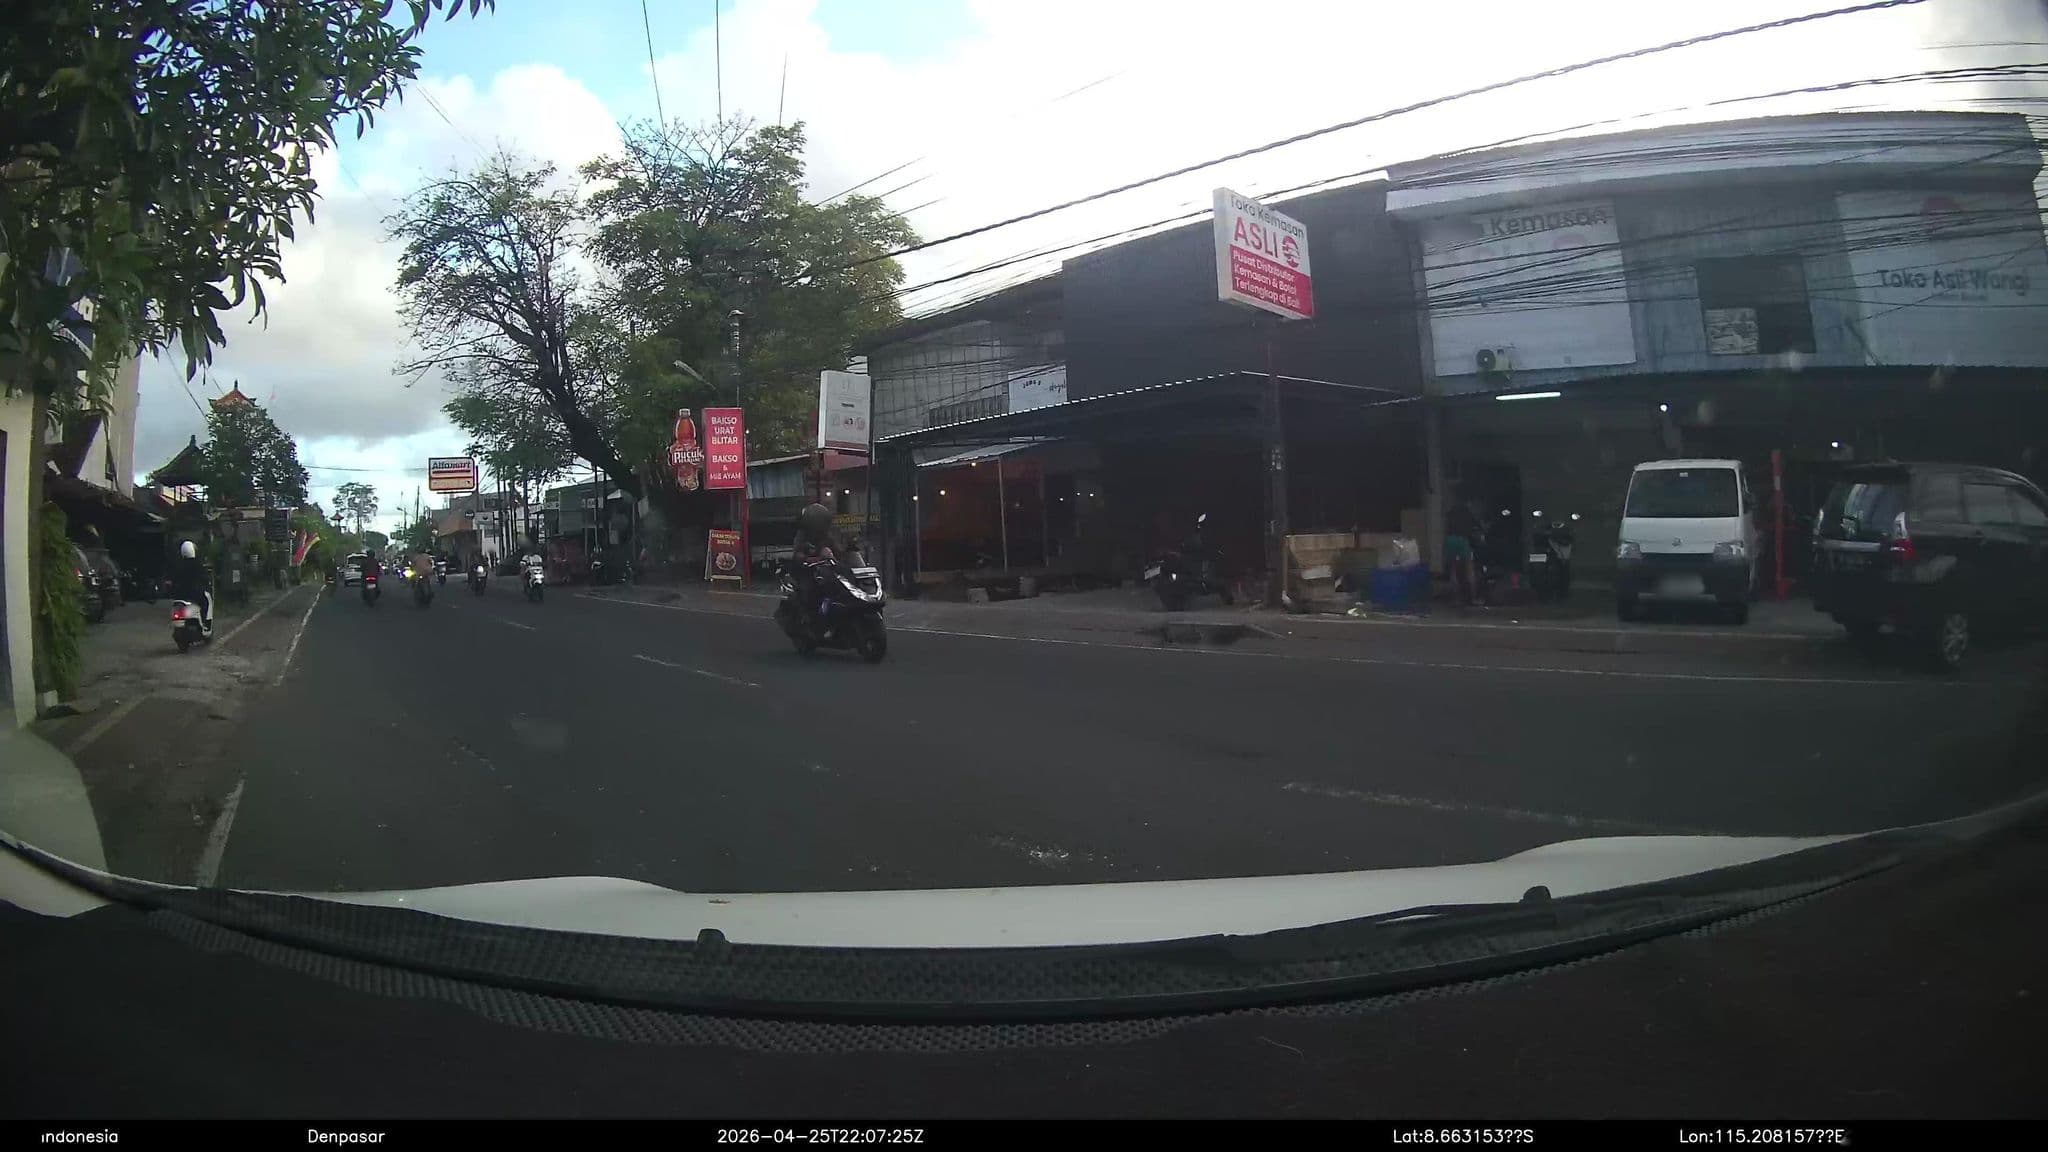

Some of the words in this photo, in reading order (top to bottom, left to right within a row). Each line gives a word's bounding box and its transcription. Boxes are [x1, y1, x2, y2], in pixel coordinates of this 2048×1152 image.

[1231, 195, 1256, 216] Toko
[1258, 207, 1304, 238] Kemasan
[1234, 216, 1279, 258] ASLI
[1233, 250, 1256, 266] Pusat
[1257, 259, 1296, 282] Distributor
[1234, 263, 1272, 285] Kemasan
[1272, 279, 1278, 288] &
[1878, 269, 1927, 288] Toko
[1235, 277, 1279, 303] Terlengkap
[1279, 293, 1286, 304] di
[712, 416, 737, 425] BAKSO
[714, 426, 735, 435] URAT
[711, 436, 738, 445] BLITAR
[431, 461, 471, 470] Alfamart
[712, 454, 738, 463] BAKSO
[722, 472, 741, 480] AYAM
